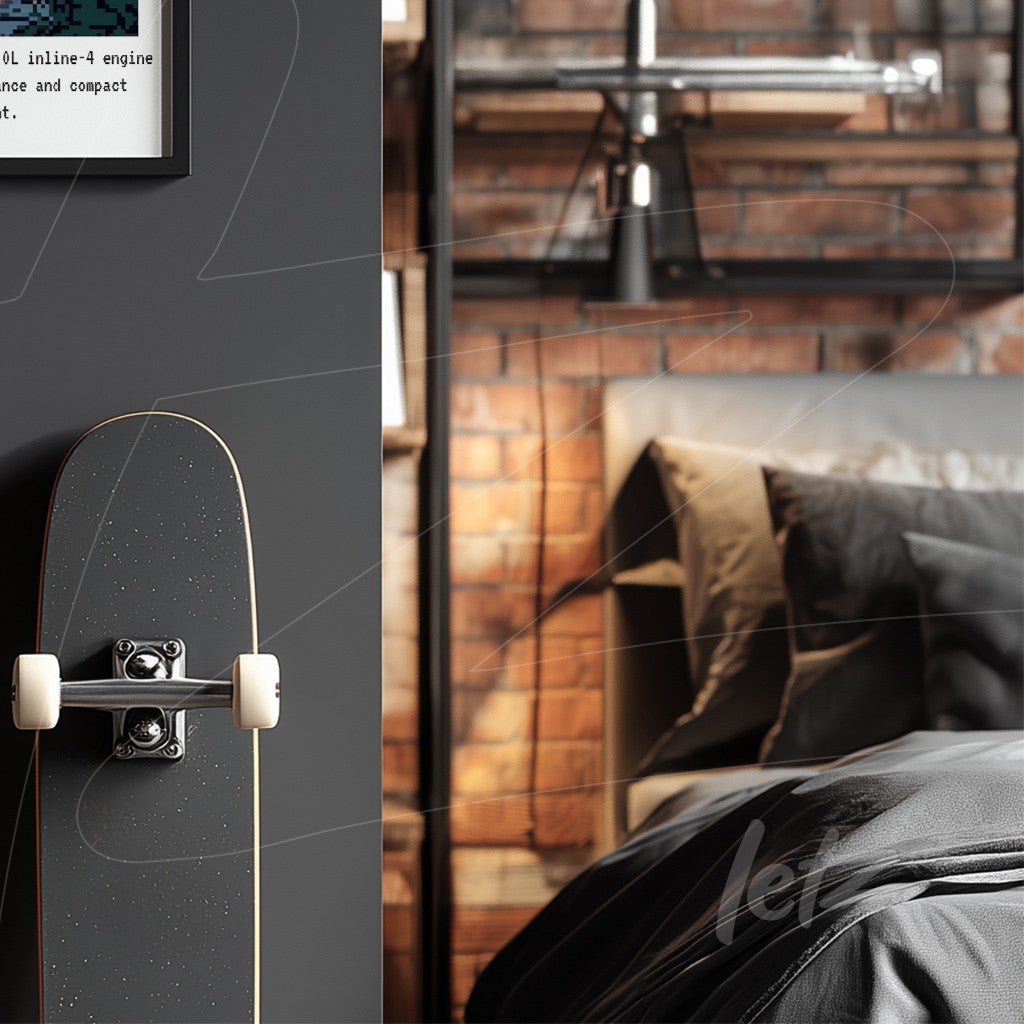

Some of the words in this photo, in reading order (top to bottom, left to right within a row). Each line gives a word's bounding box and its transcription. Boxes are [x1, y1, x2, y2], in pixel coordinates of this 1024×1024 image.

[28, 50, 95, 65] inline-4
[102, 50, 153, 68] engine
[35, 78, 61, 92] and
[69, 78, 127, 96] compact
